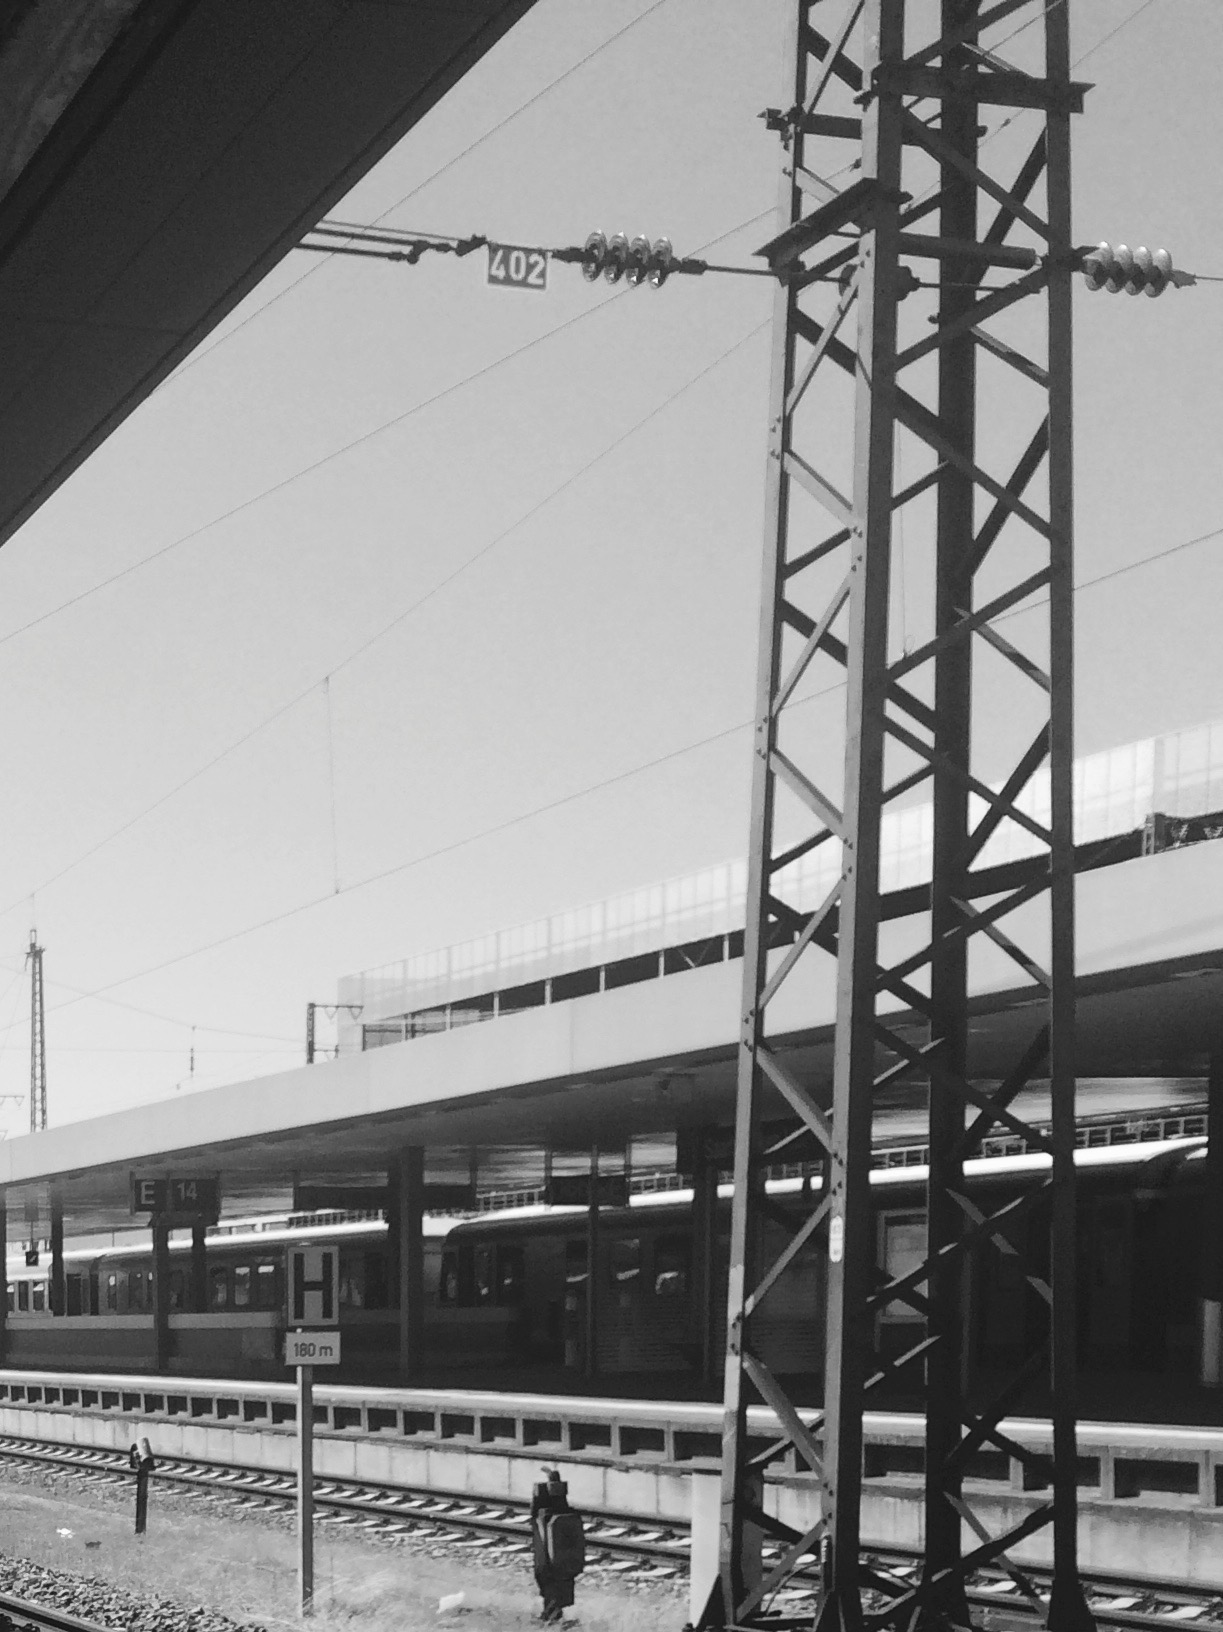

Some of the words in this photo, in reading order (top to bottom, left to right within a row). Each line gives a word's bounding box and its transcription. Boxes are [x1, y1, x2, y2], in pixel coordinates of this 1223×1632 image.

[490, 249, 545, 285] 402
[140, 1181, 156, 1204] E
[177, 1182, 198, 1201] 14
[294, 1252, 333, 1320] H
[293, 1342, 316, 1358] 180
[319, 1345, 334, 1357] m
